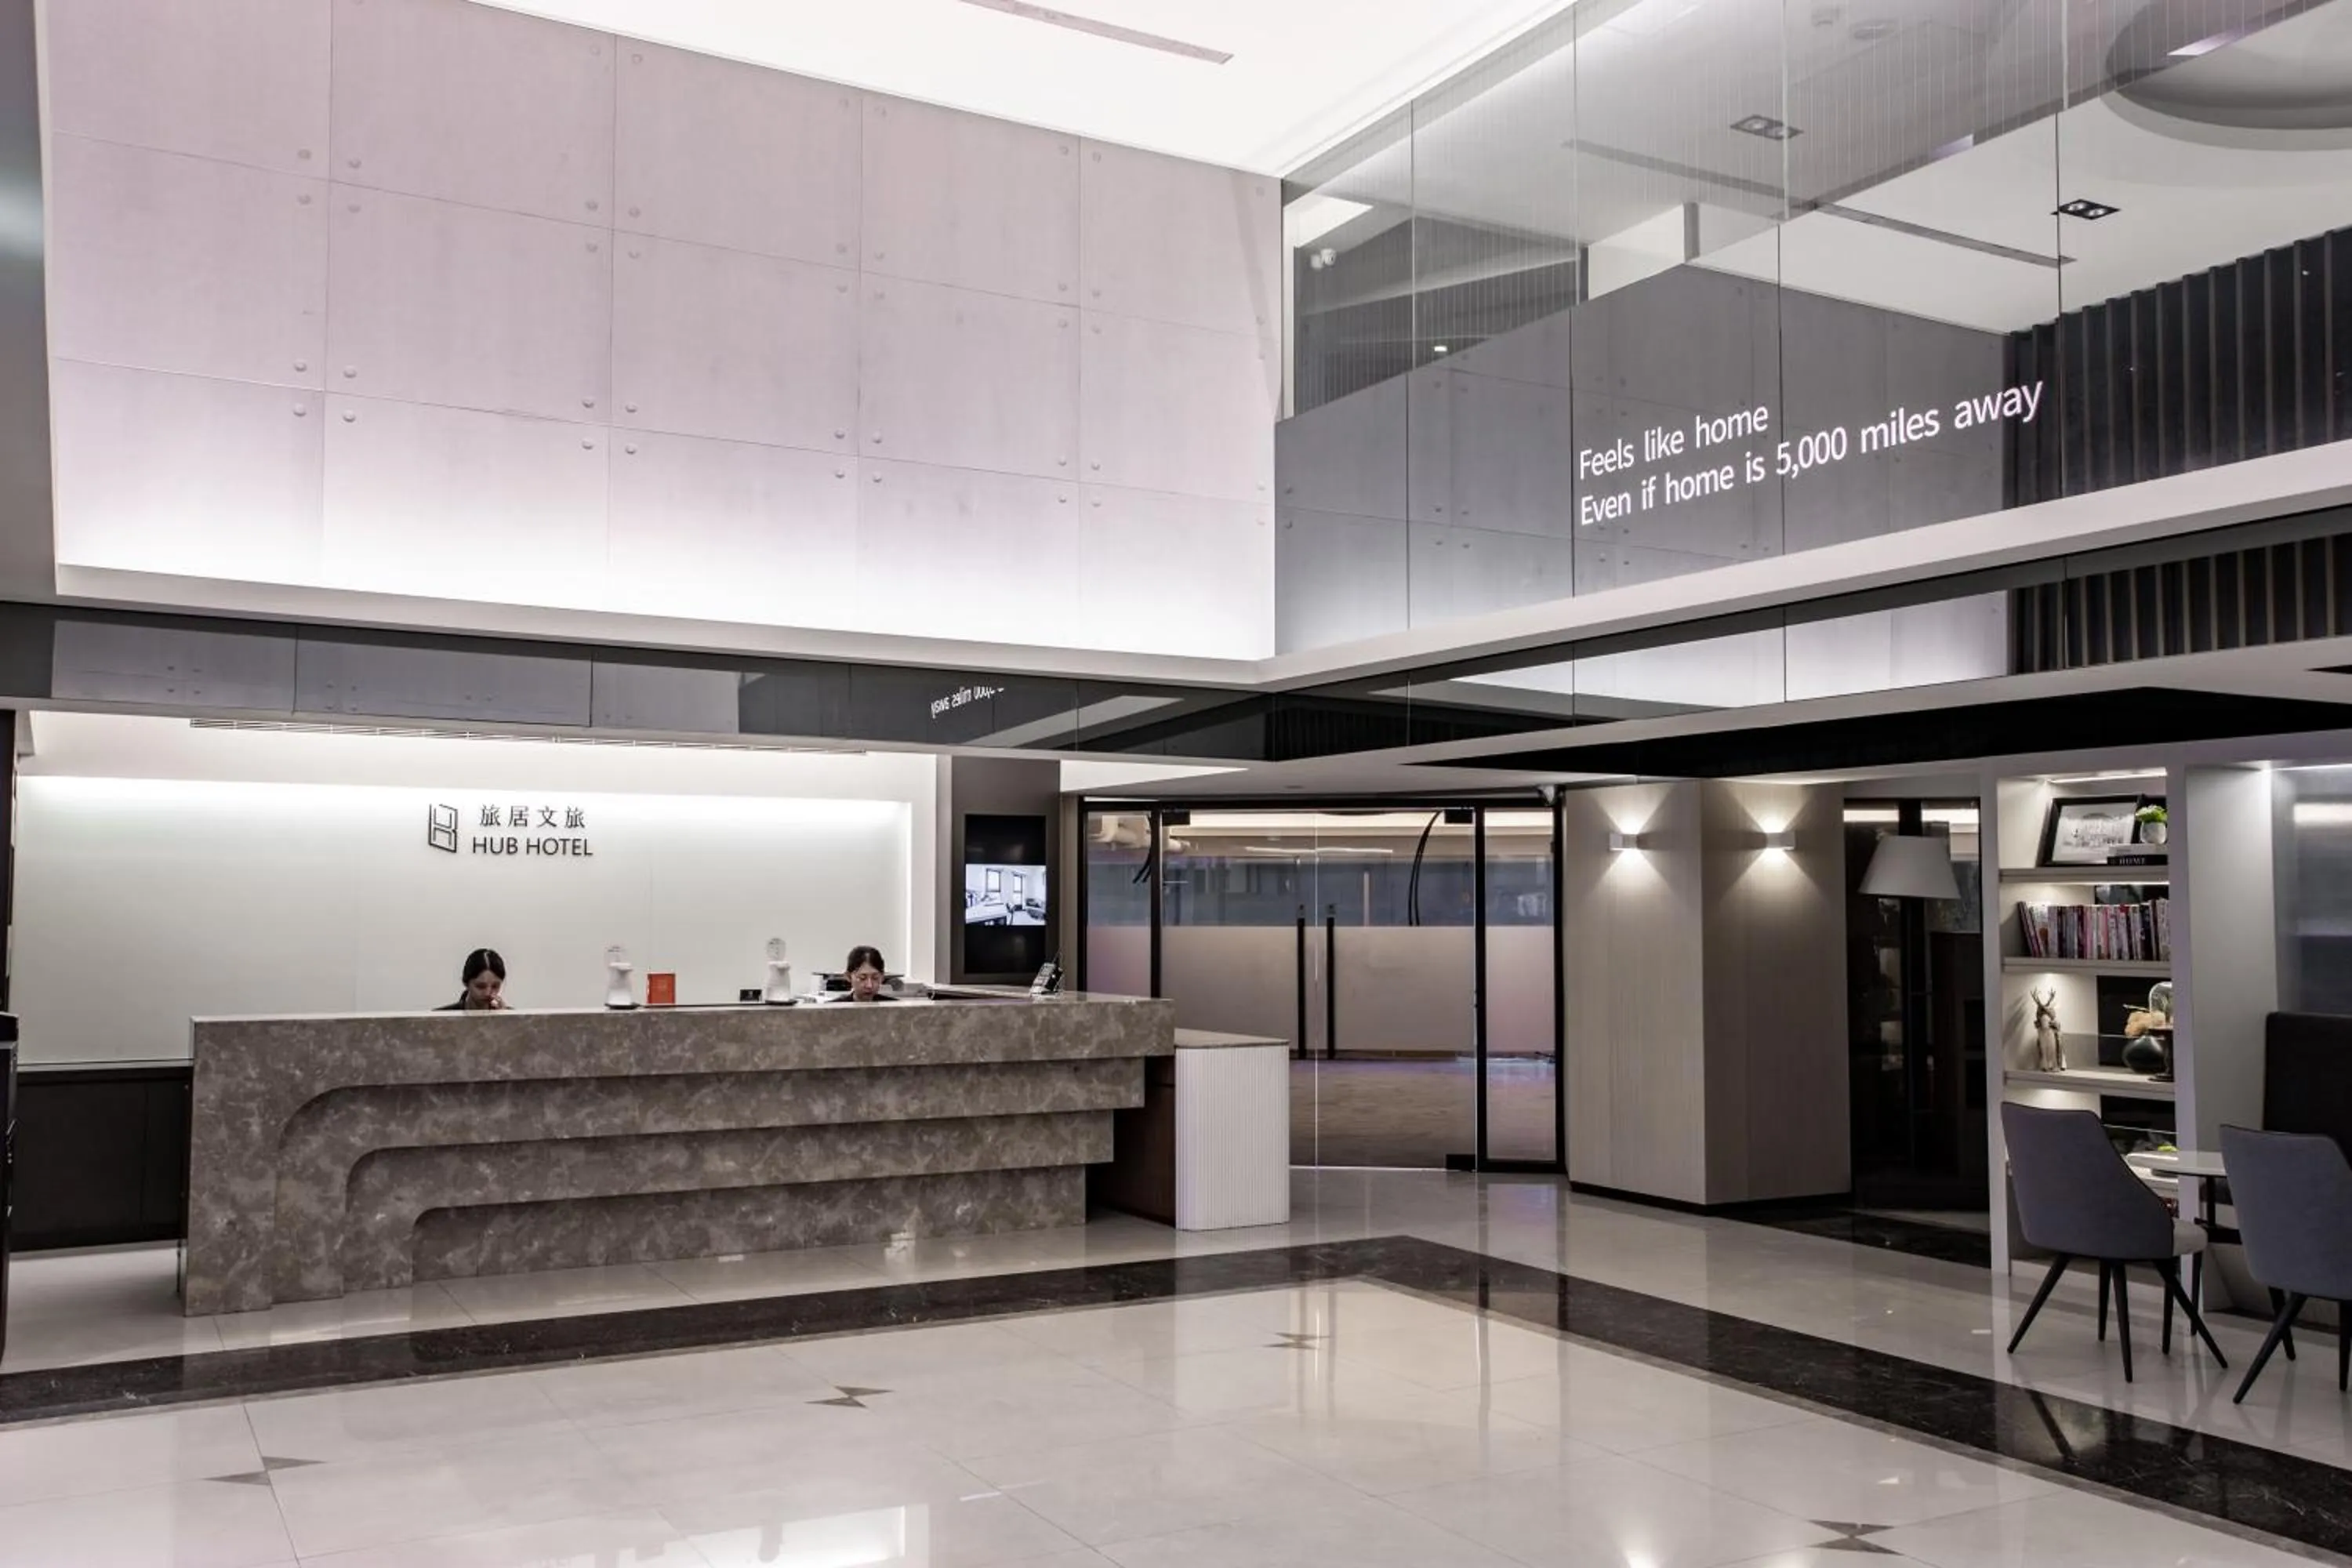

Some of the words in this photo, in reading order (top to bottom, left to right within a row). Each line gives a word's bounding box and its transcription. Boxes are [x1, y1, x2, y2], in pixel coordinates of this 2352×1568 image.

[1580, 438, 1635, 481] Feels
[1644, 429, 1685, 463] like
[1695, 406, 1769, 449] home
[1581, 492, 1632, 527] Even
[1641, 476, 1657, 510] if
[1664, 465, 1735, 505] home
[1744, 451, 1766, 484] is
[1776, 426, 1848, 479] 5,000
[1860, 407, 1940, 454] miles
[1954, 381, 2042, 430] away
[480, 804, 586, 829] 旅居文旅
[472, 837, 518, 856] HUB
[525, 837, 593, 857] HOTEL
